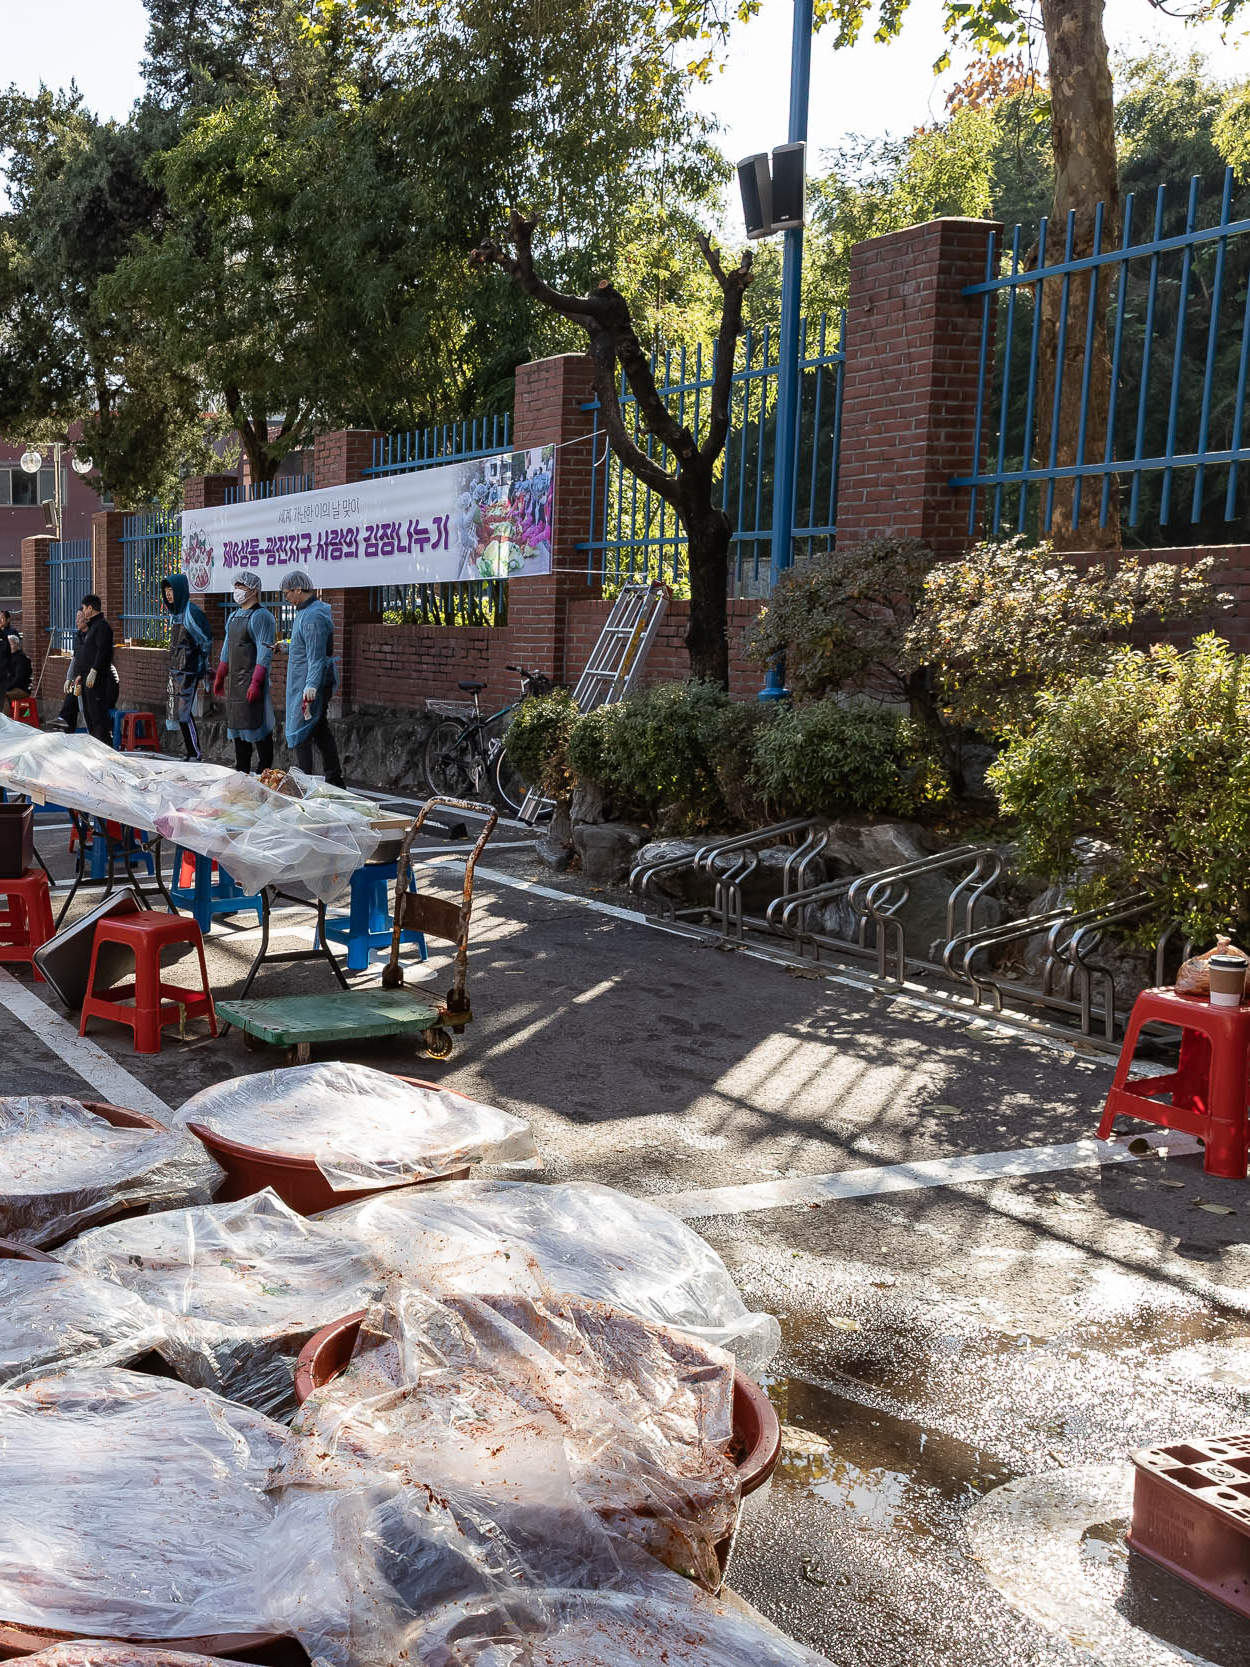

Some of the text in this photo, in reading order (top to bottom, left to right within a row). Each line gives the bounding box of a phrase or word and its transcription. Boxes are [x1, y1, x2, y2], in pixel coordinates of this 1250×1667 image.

[294, 504, 313, 524] 가난한
[314, 501, 330, 518] 이의
[332, 500, 341, 519] 날
[342, 497, 360, 518] 맞이
[222, 532, 312, 568] 제8성동-광진지구
[315, 526, 360, 561] 사랑의
